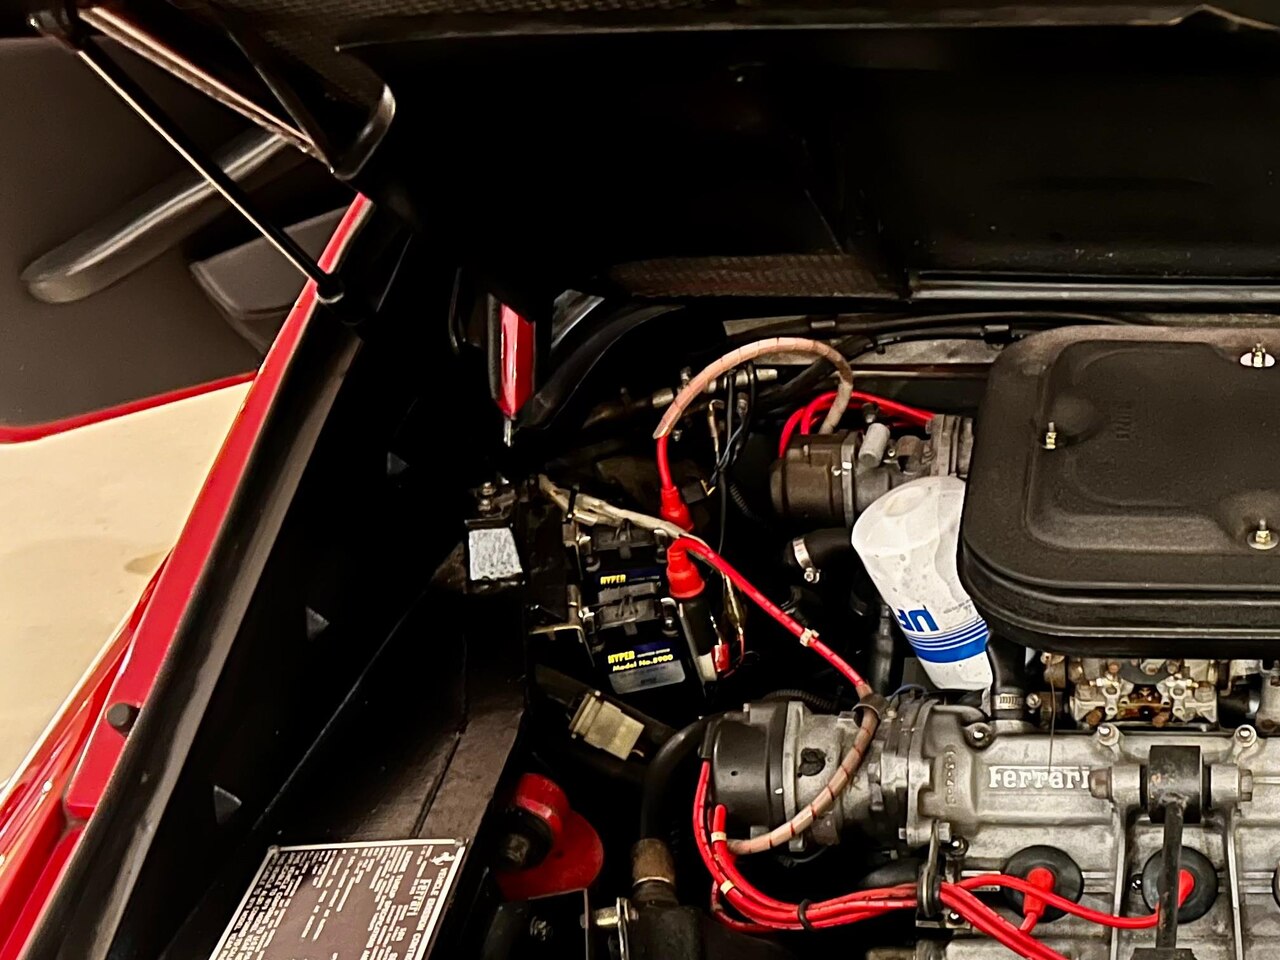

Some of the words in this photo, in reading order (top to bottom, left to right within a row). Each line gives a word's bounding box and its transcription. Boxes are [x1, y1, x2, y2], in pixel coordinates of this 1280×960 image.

[608, 650, 635, 664] HYPER
[988, 766, 1090, 788] Ferrari
[430, 868, 448, 895] VEHICLE
[407, 879, 432, 916] Ferrari
